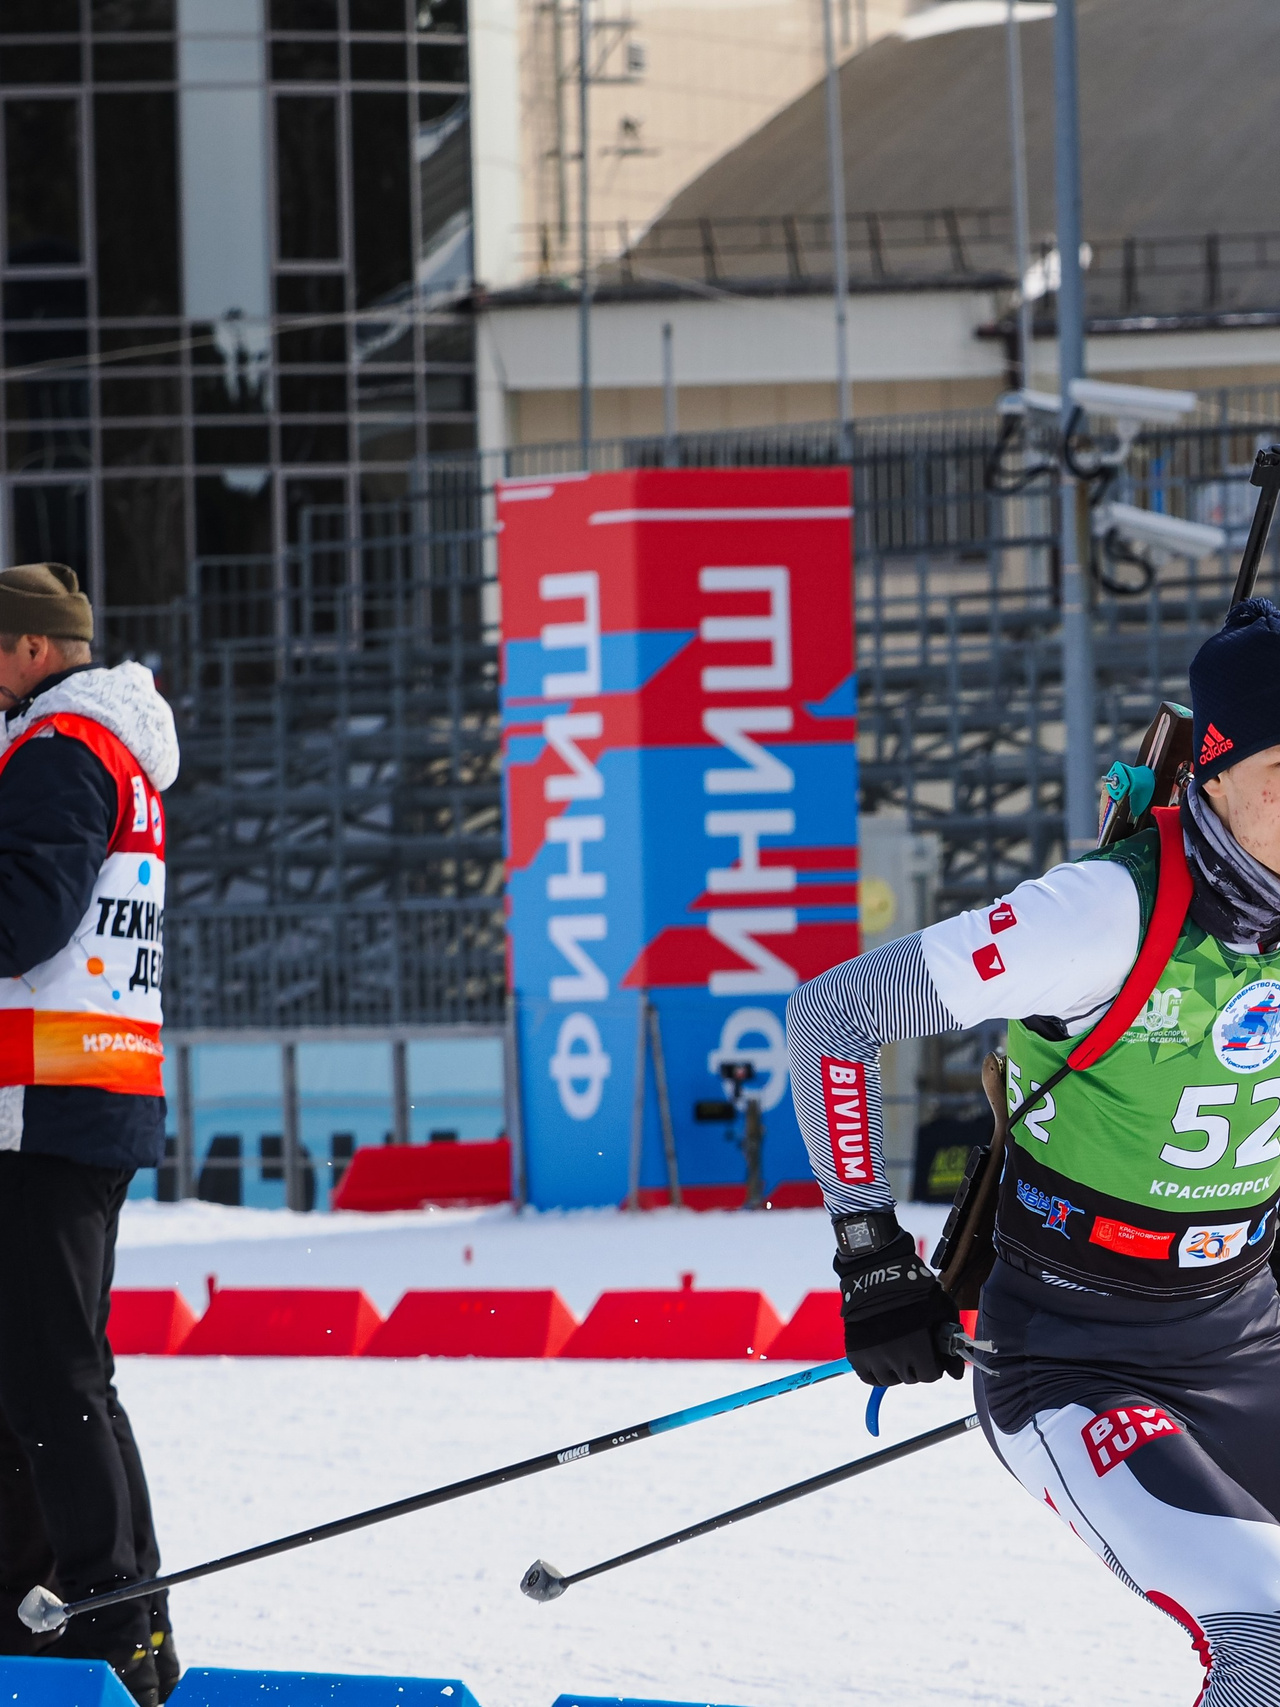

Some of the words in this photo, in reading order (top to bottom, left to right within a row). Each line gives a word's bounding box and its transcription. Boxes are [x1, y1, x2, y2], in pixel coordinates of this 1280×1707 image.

[1199, 738, 1234, 765] adidas
[540, 570, 611, 1120] ФИНИШ
[698, 565, 800, 1114] ФИНИШ
[1225, 981, 1270, 1013] ПЕРВЕНСТВО
[1149, 1036, 1190, 1044] ФЕДЕРАЦИИ
[1225, 1056, 1260, 1070] Красноярск
[1262, 1048, 1278, 1065] 2023
[1007, 1056, 1057, 1145] 52
[829, 1064, 867, 1179] BIVIUM
[1149, 1174, 1273, 1199] КРАСНОЯРСК
[1117, 1231, 1135, 1240] КРАЙ
[1119, 1225, 1170, 1241] КРАСНОЯРСКИЙ
[1088, 1408, 1157, 1447] BIV
[1097, 1417, 1174, 1468] IUM
